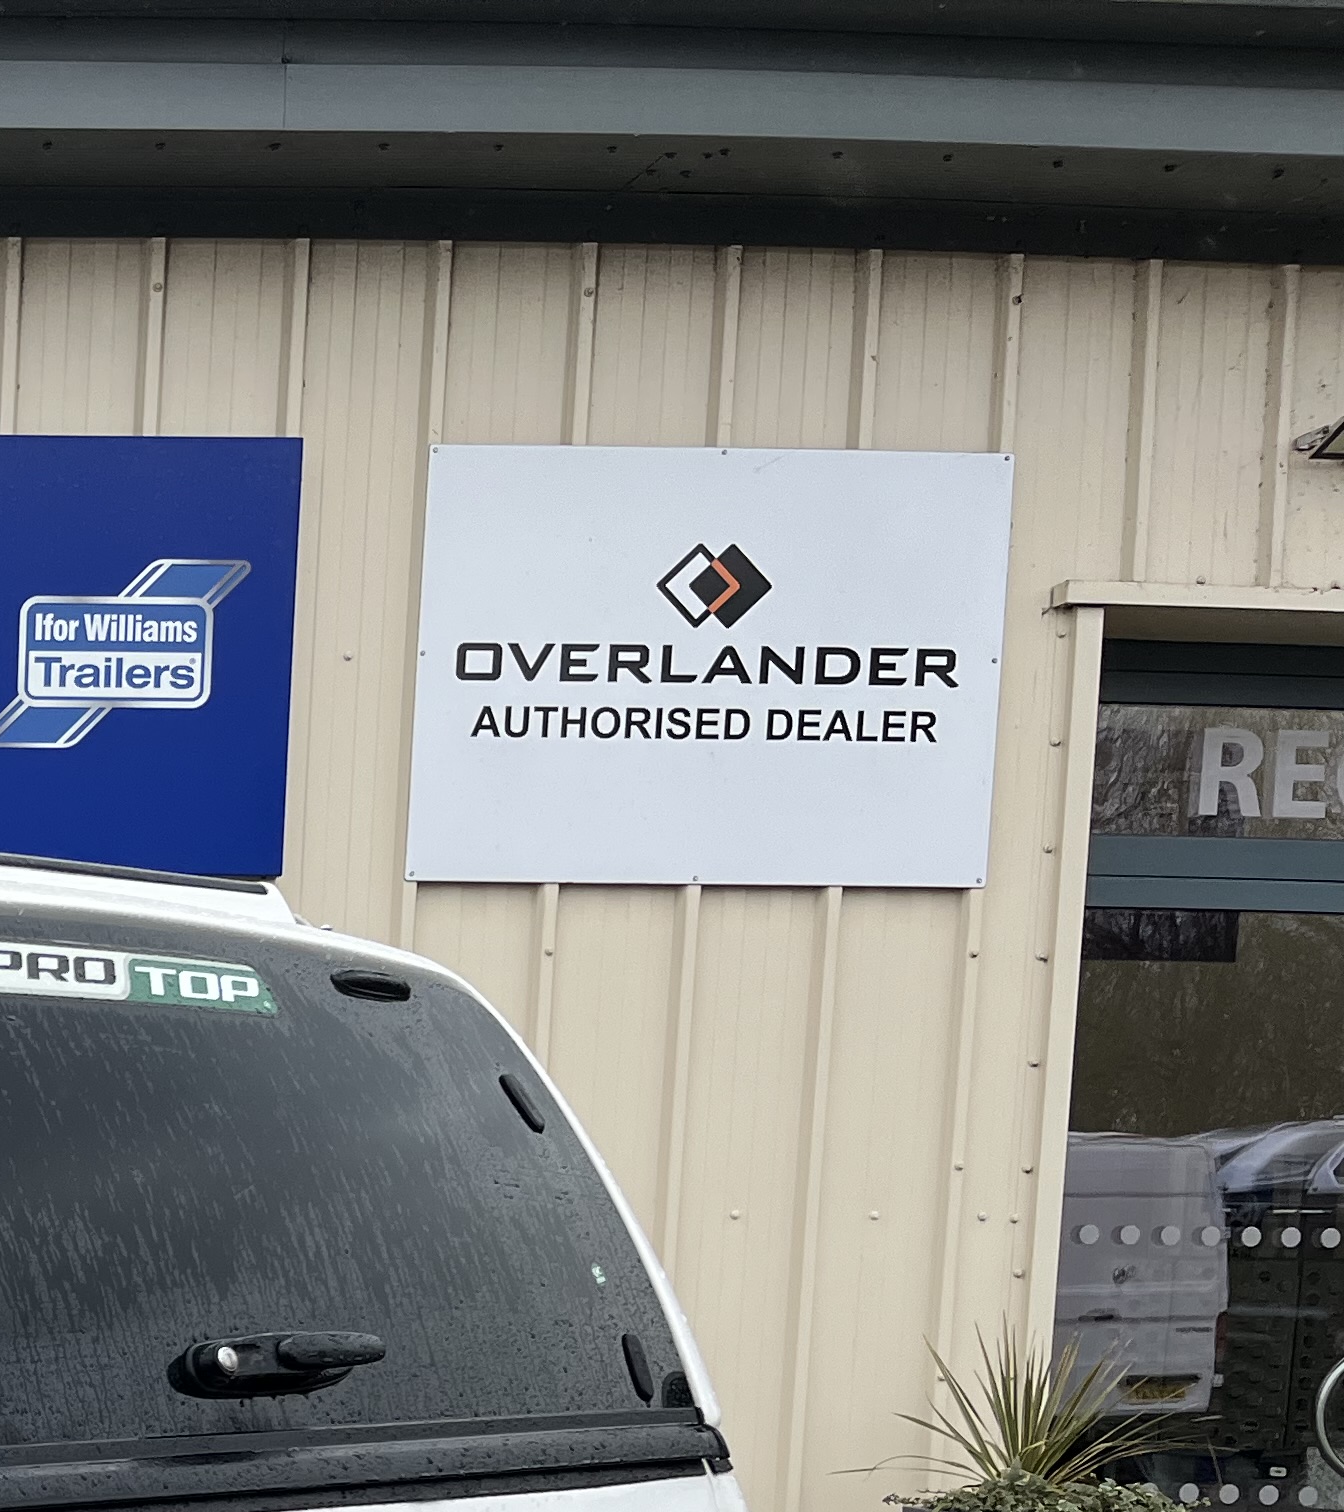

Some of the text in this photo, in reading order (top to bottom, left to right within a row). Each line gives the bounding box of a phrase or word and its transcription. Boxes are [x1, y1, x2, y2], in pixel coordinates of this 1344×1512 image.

[34, 612, 198, 643] Ifor Williams
[34, 656, 195, 690] Trailers
[455, 642, 959, 688] OVERLANDER
[470, 705, 938, 744] AUTHORISED DEALER
[1198, 727, 1344, 819] RE
